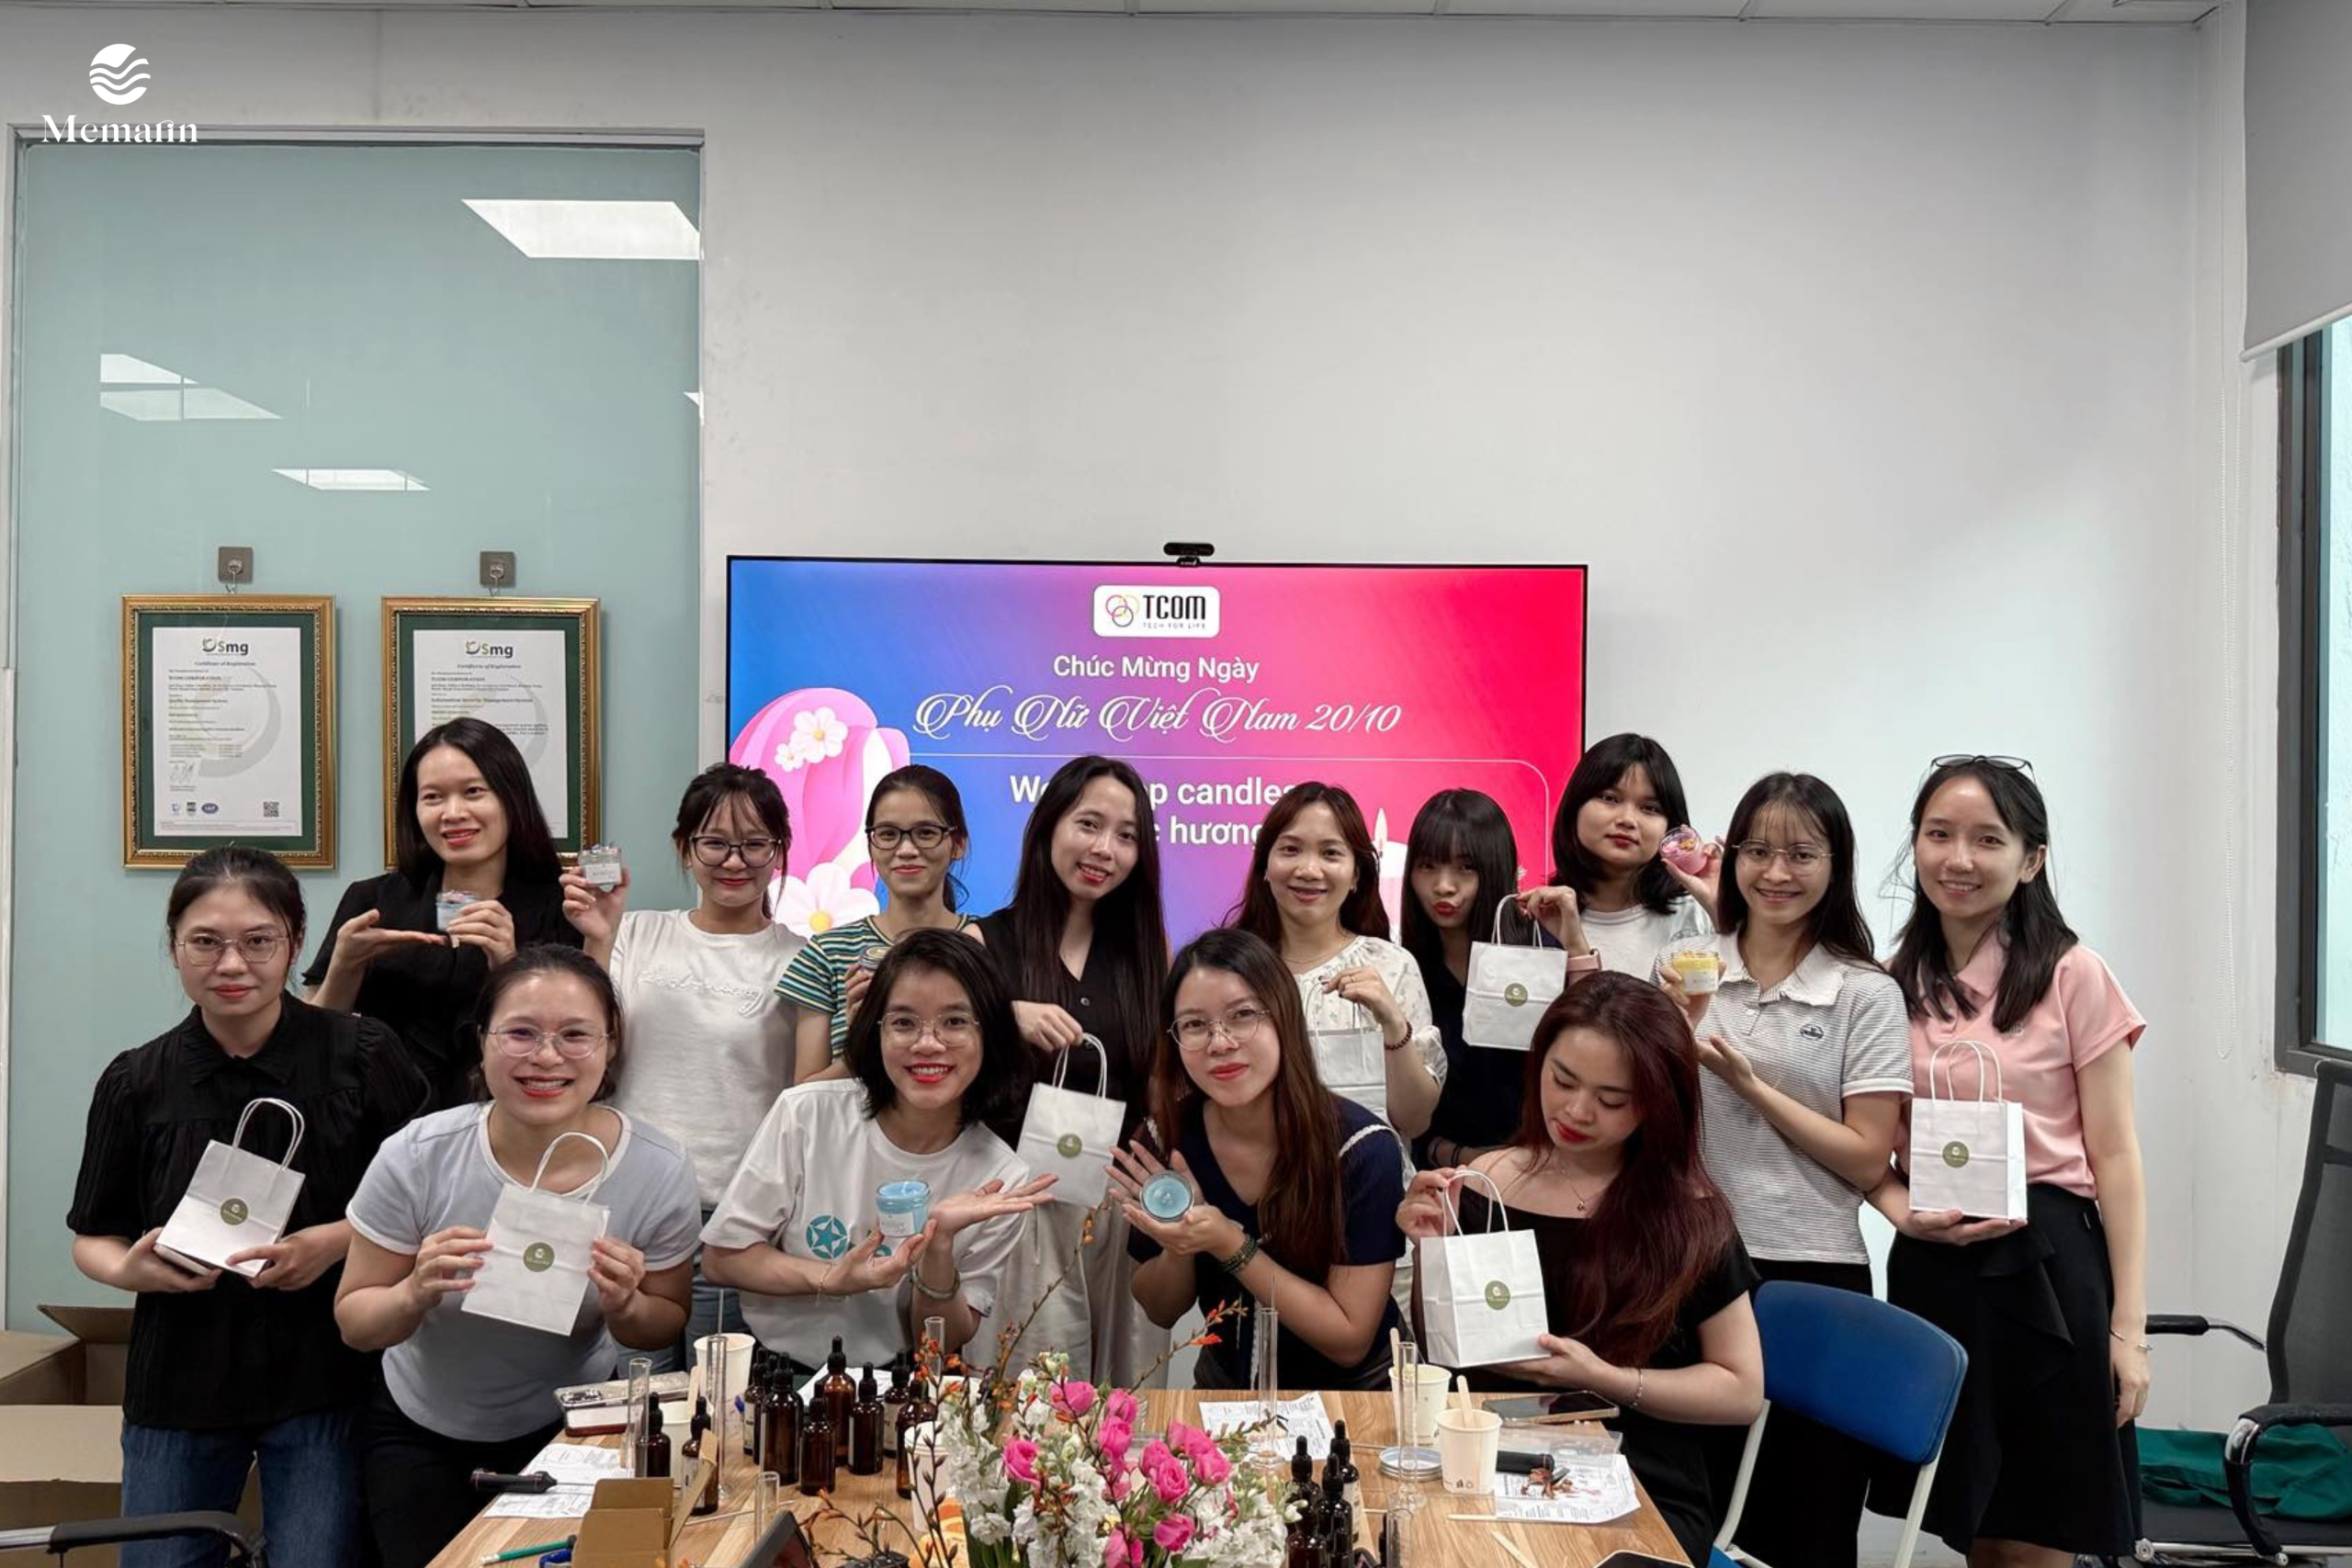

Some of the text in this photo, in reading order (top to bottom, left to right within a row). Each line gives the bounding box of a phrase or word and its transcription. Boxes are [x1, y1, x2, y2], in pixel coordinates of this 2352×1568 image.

[1143, 594, 1206, 620] TCOM
[1053, 655, 1260, 683] Chúc Mừng Ngày
[912, 684, 1402, 744] Phụ Nữ Việt Nam 20/10
